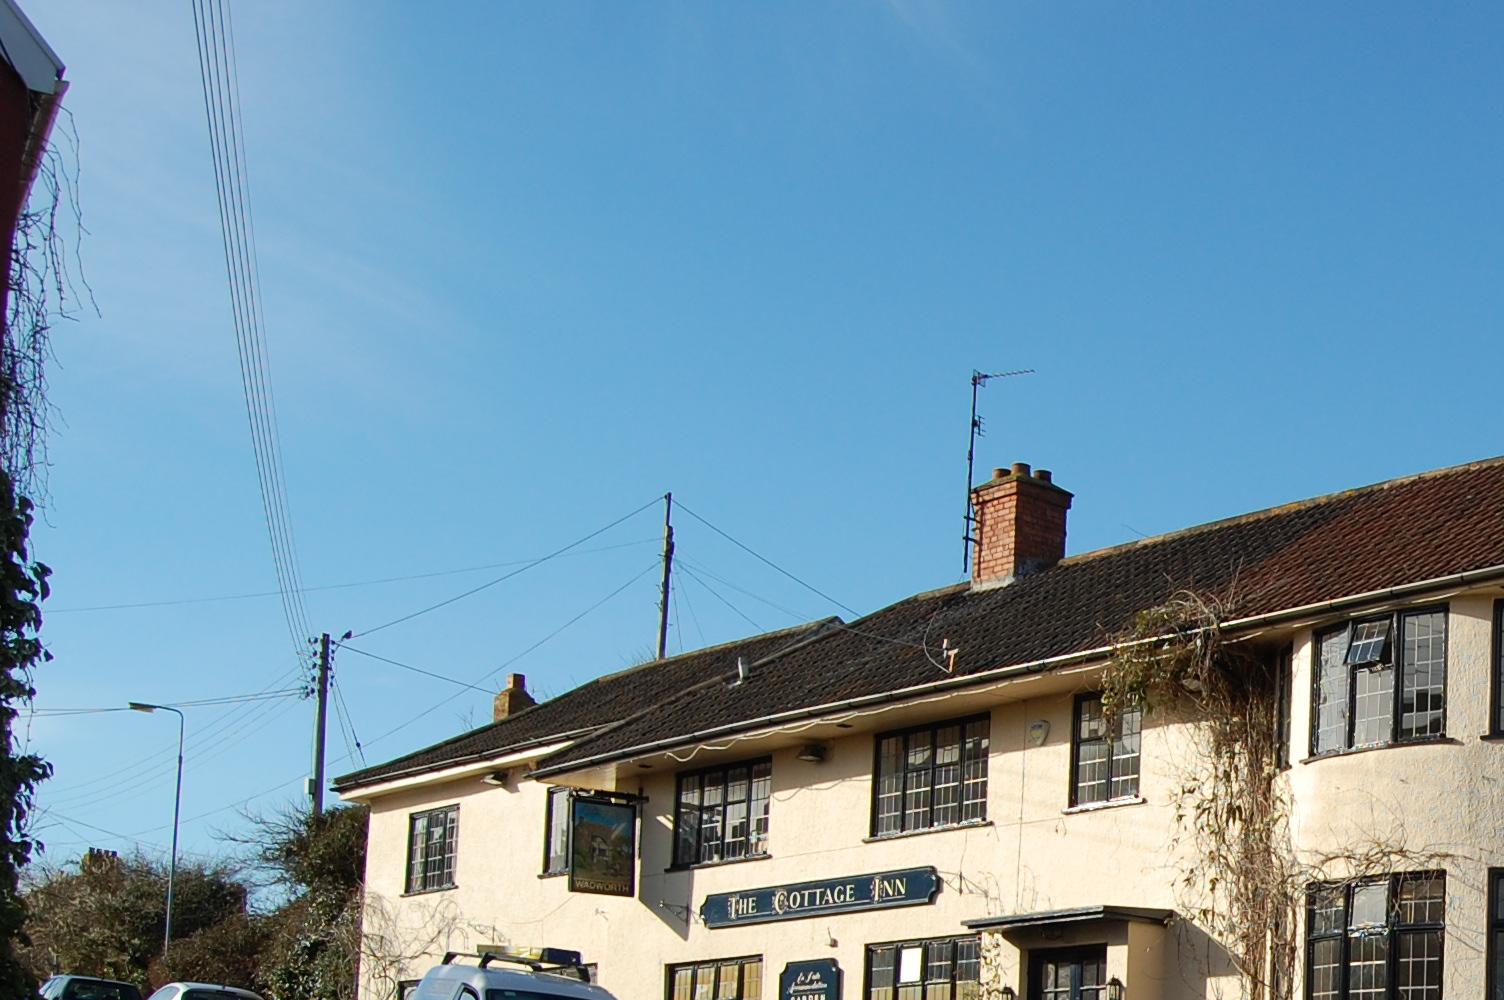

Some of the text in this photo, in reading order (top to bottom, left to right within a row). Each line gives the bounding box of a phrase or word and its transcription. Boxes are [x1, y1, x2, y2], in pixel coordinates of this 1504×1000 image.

[728, 877, 906, 919] THE COTTAGE INN
